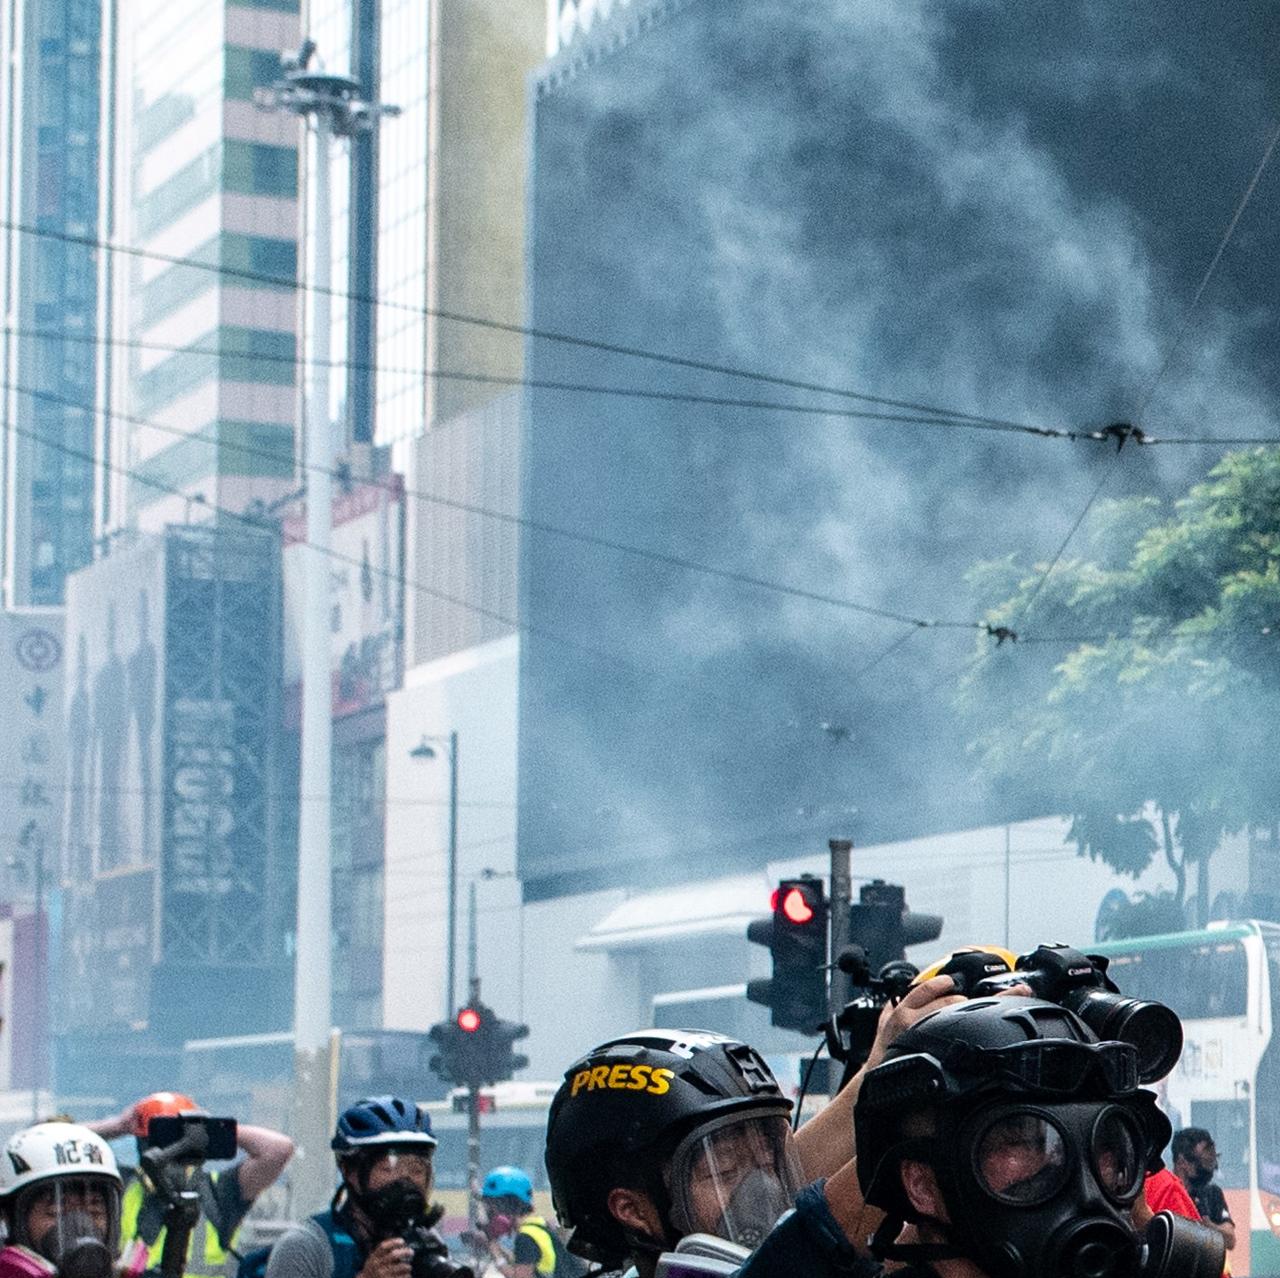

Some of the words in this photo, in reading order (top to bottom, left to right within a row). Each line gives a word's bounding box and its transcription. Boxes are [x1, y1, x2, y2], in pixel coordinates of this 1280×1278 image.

[1068, 966, 1092, 976] Canon
[571, 1064, 675, 1096] PRESS
[53, 1140, 103, 1165] 記者
